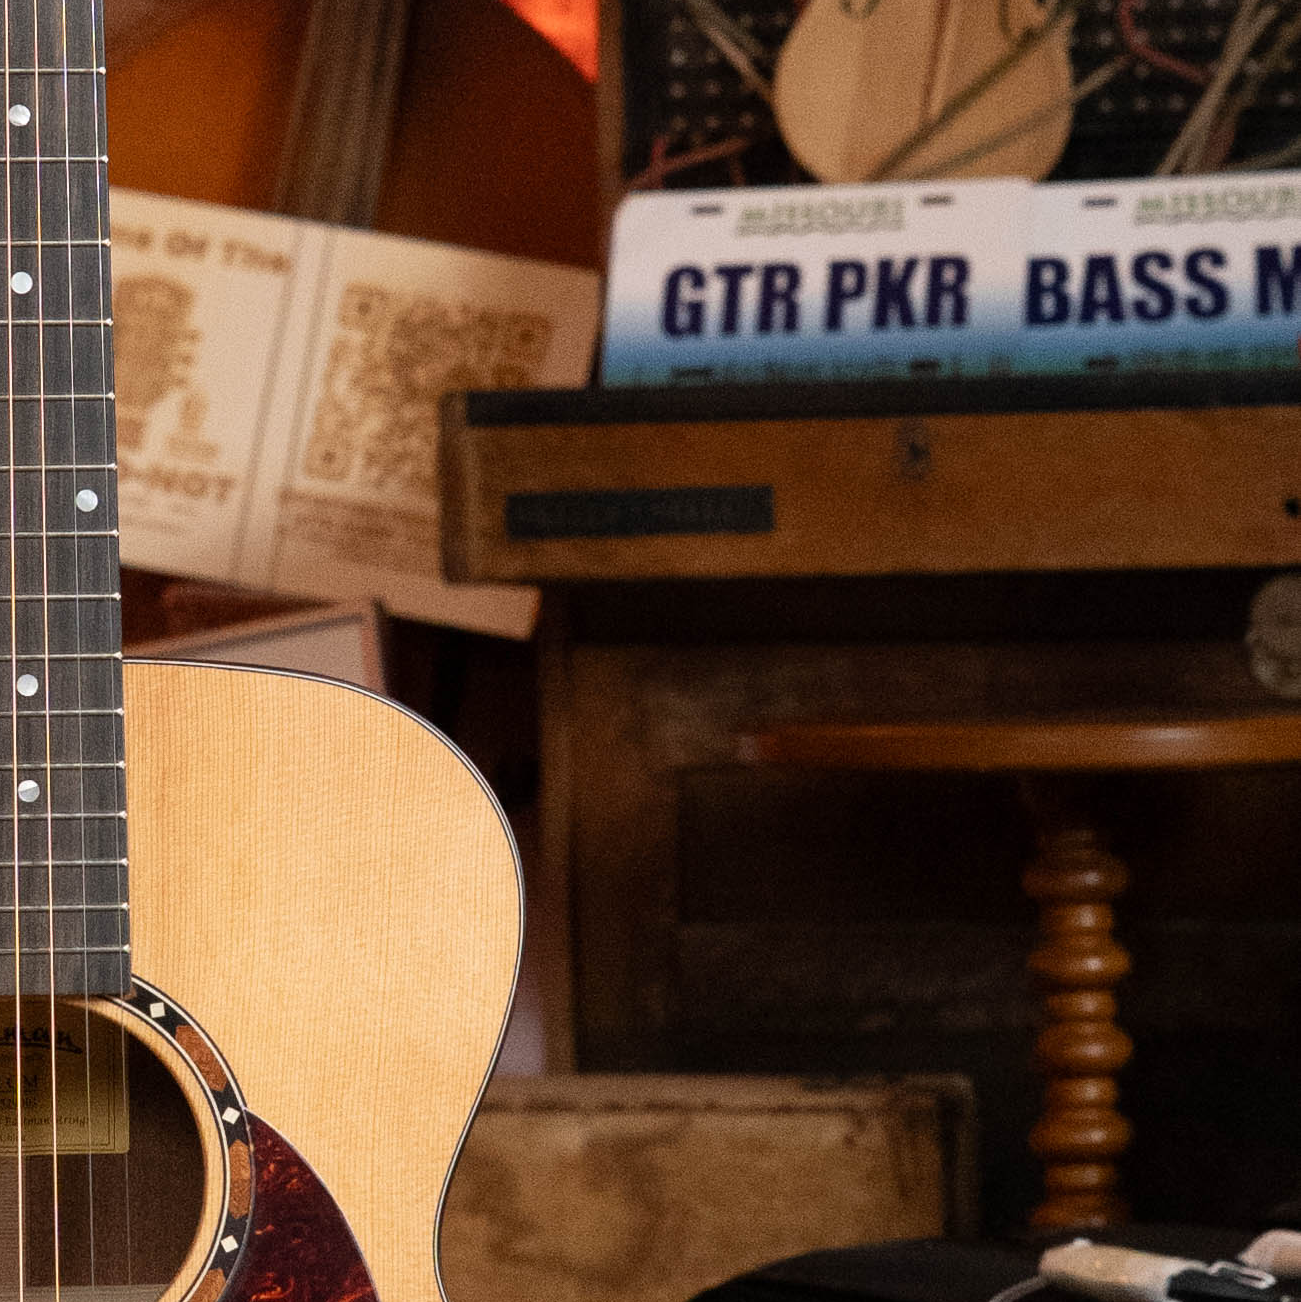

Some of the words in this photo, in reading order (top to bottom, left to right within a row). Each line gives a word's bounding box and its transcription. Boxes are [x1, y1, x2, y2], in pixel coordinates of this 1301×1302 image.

[660, 263, 803, 338] GTR
[825, 255, 970, 331] PKR
[1025, 249, 1230, 326] BASS
